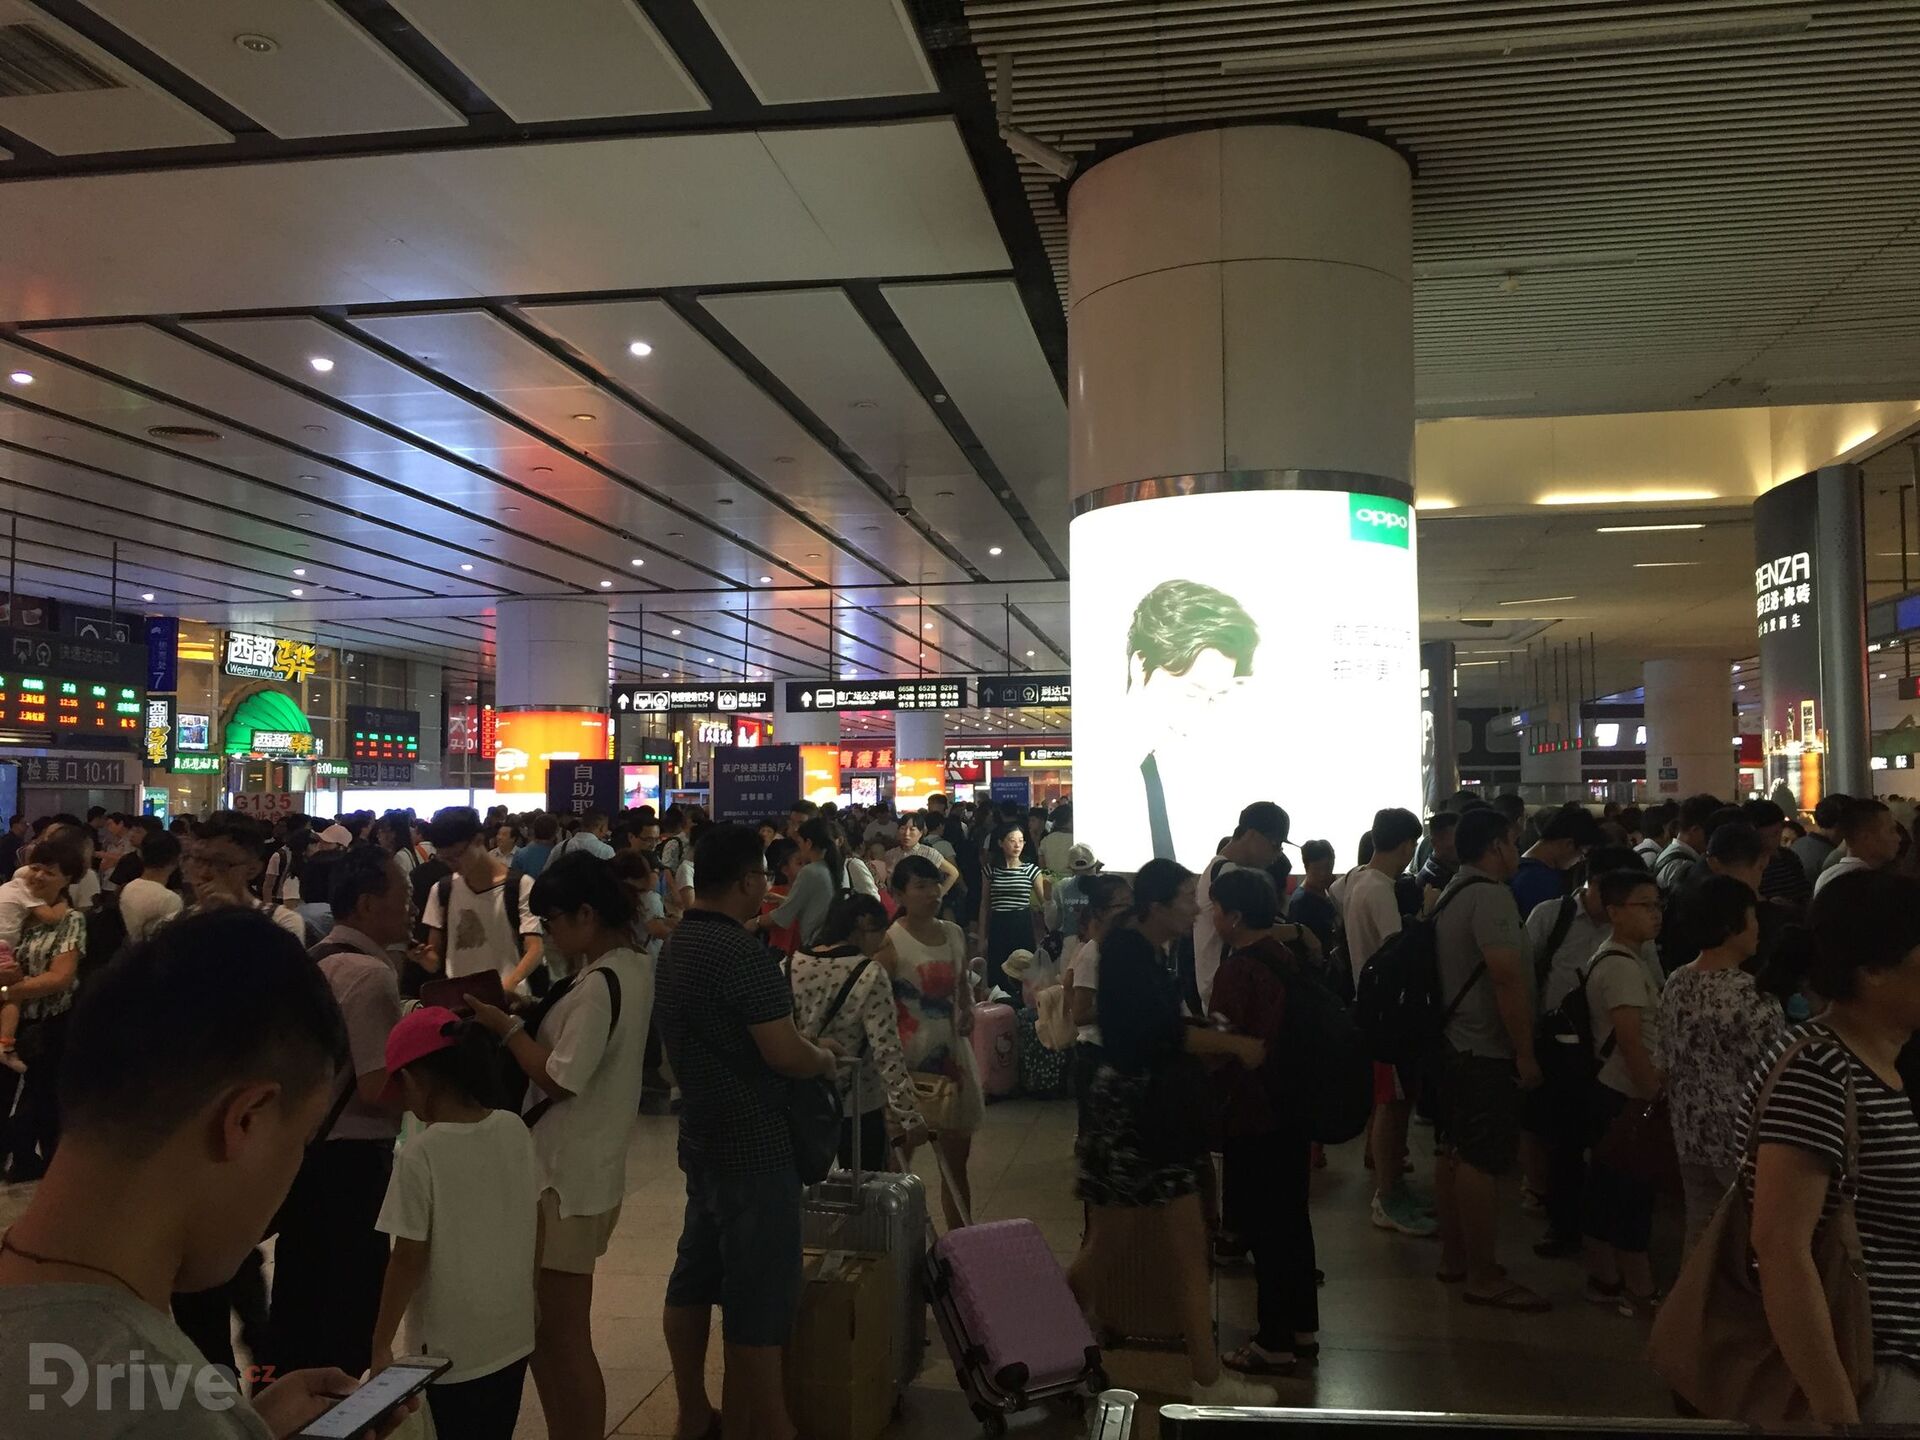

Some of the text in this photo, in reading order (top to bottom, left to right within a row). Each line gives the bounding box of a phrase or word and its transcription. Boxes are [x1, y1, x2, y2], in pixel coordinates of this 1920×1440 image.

[230, 663, 259, 676] Western
[153, 671, 164, 689] 7
[234, 794, 291, 810] G135
